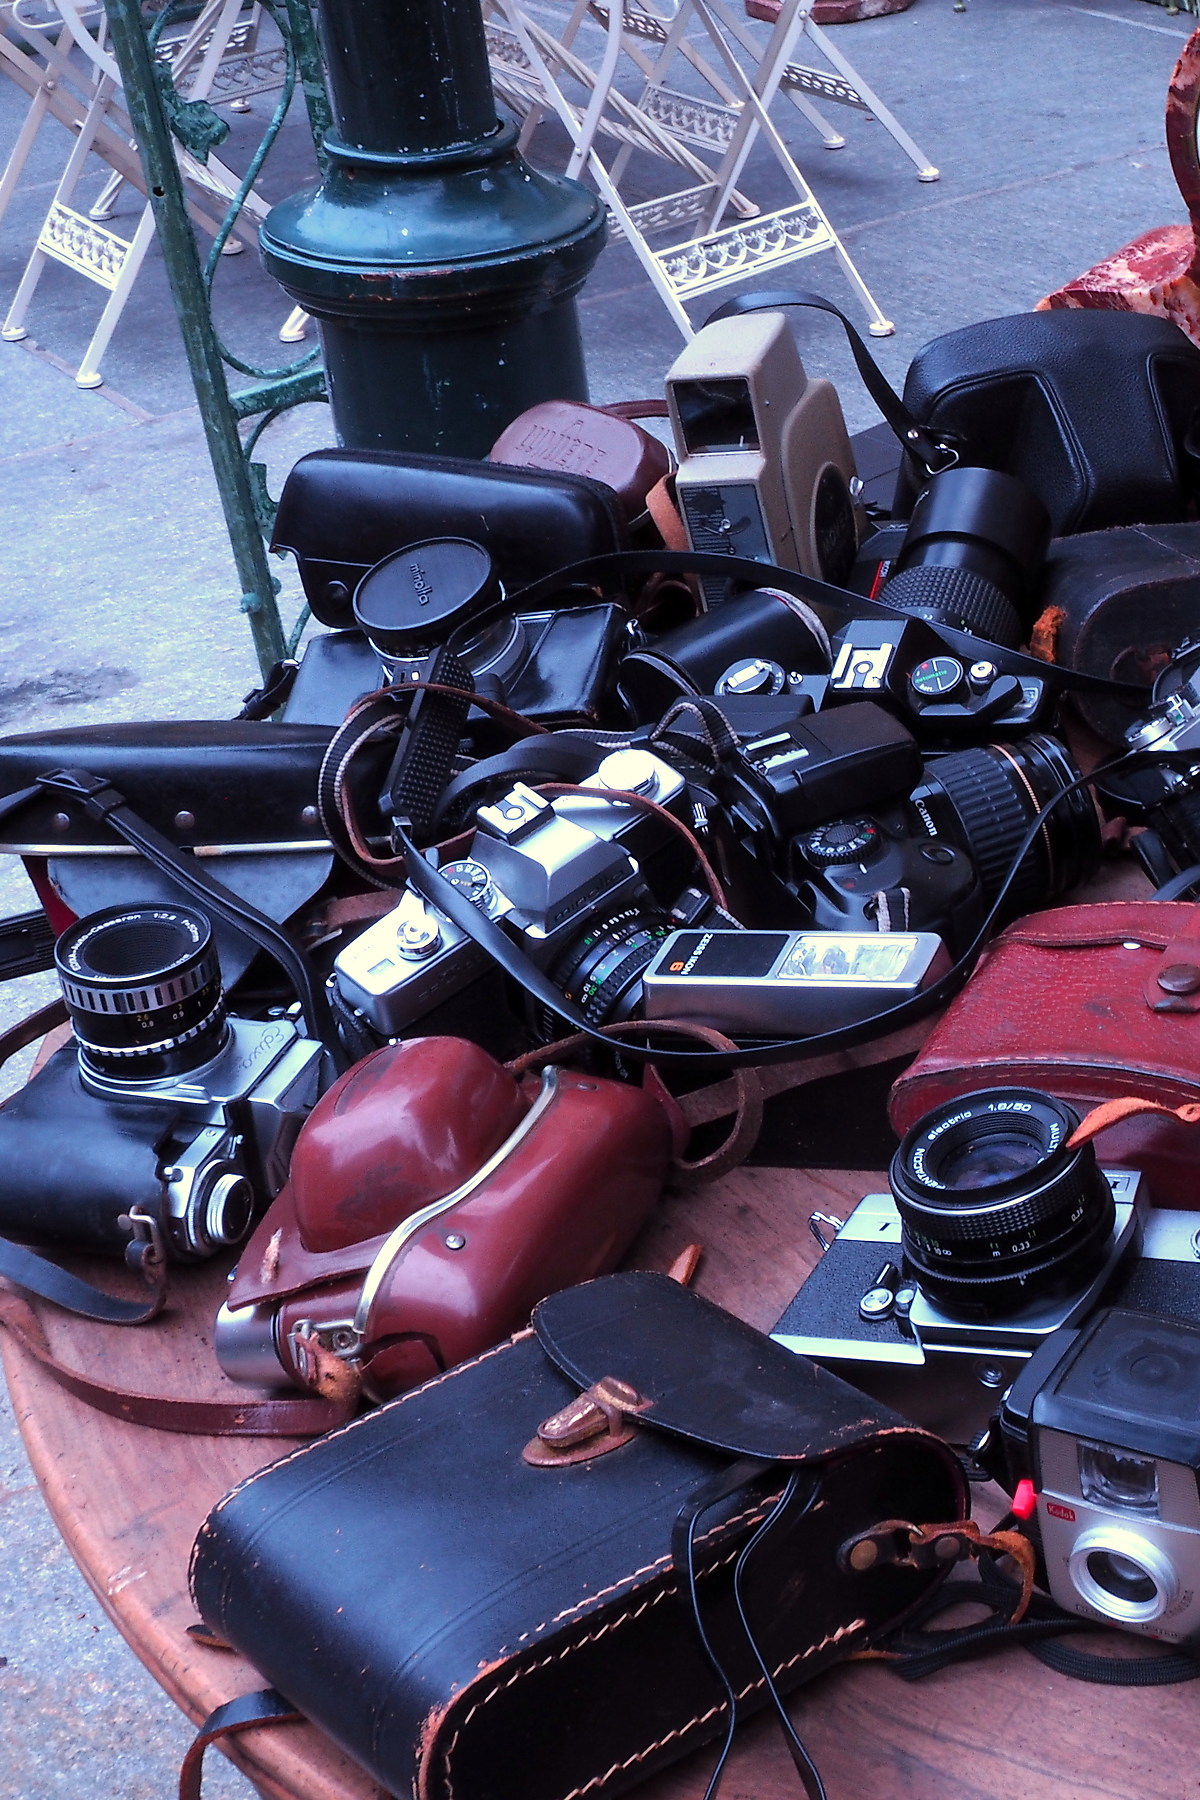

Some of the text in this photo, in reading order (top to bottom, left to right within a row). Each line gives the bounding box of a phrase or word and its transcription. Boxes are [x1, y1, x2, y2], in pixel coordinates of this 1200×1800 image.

[410, 563, 433, 606] minolta
[915, 669, 948, 684] automatic
[914, 799, 938, 836] Canon
[555, 870, 624, 920] minolta
[680, 933, 713, 975] ZEISS IKON
[583, 983, 591, 992] 10
[172, 1011, 184, 1020] 0.9
[141, 1021, 154, 1029] 0.8
[927, 1111, 972, 1141] electric
[988, 1102, 1032, 1112] 1.8/50
[1011, 1241, 1031, 1253] 0.33
[1048, 1504, 1075, 1520] Kodak
